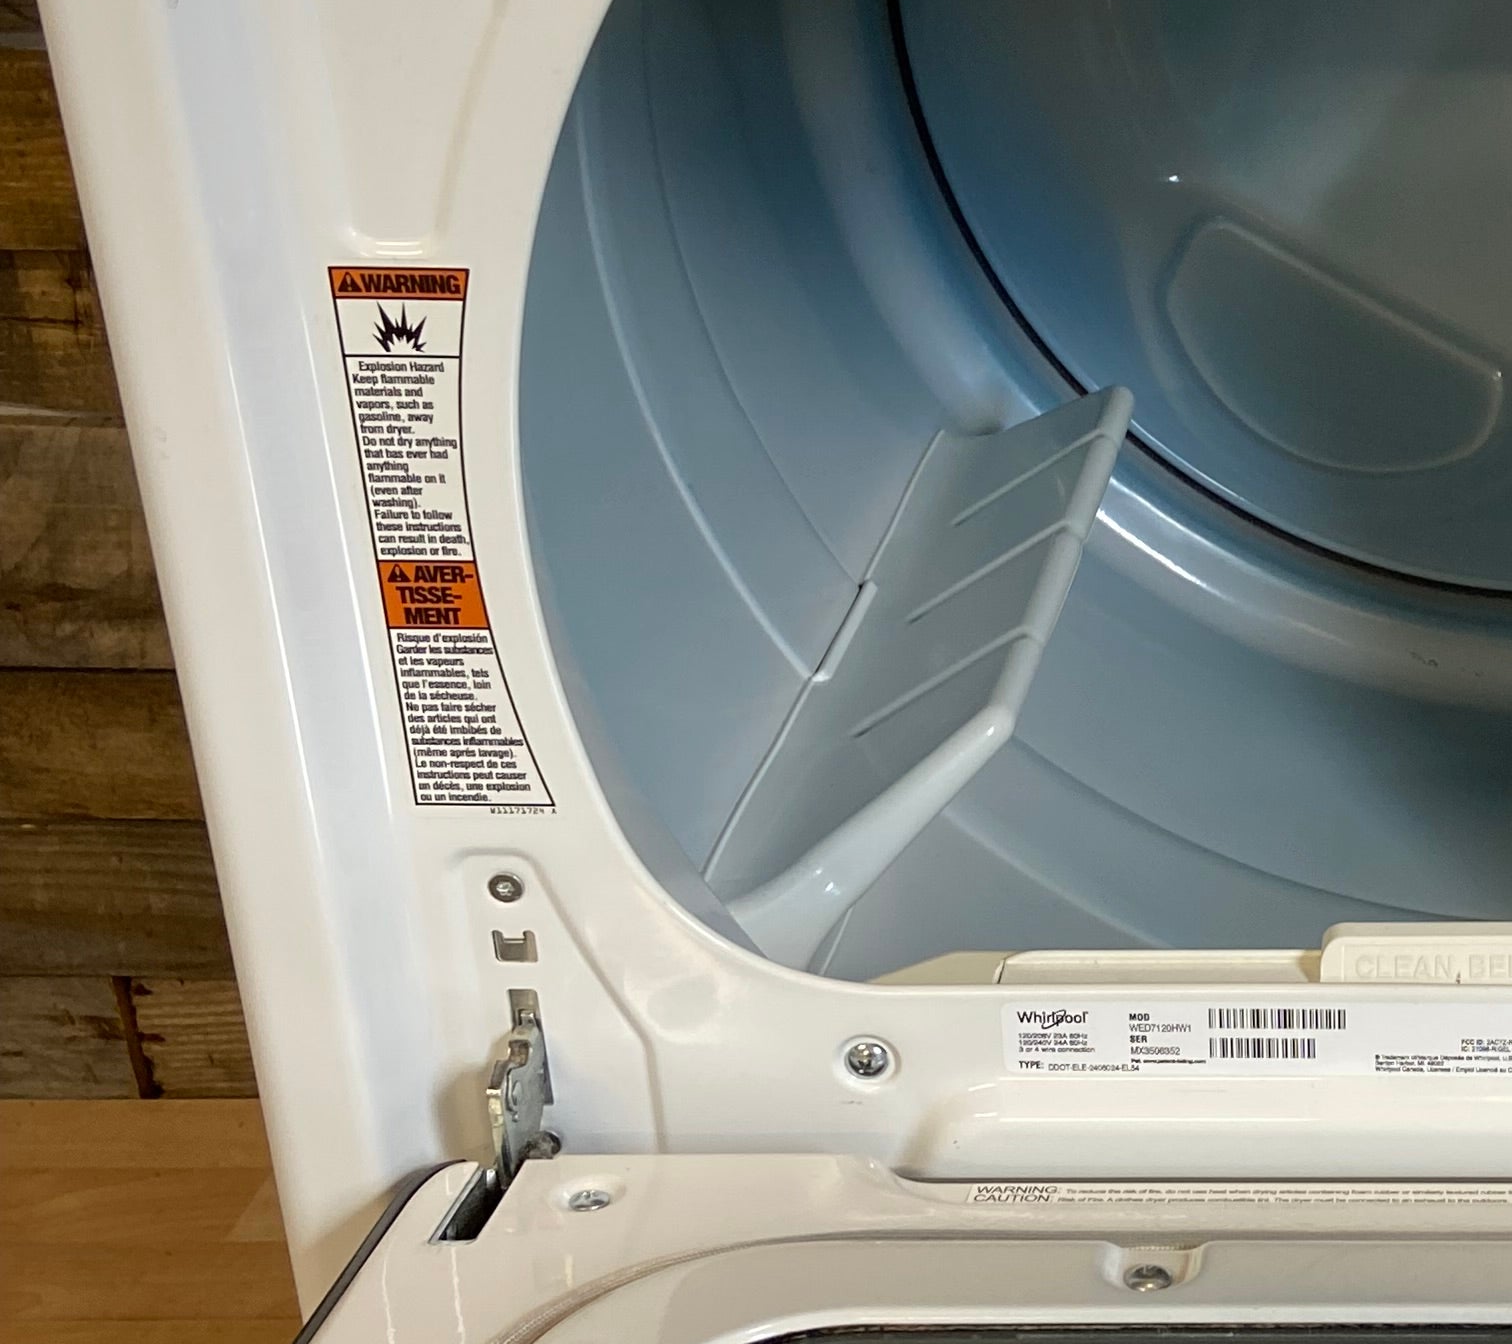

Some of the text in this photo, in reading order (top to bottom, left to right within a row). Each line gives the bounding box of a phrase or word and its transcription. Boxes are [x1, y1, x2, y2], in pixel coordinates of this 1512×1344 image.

[361, 274, 460, 294] WARNING
[359, 361, 444, 373] Explosion Hazard
[353, 374, 434, 386] Keep flammable
[355, 387, 423, 397] materials and
[356, 400, 394, 411] vapors,
[397, 400, 419, 409] such
[359, 413, 433, 424] gasoline, away
[361, 425, 414, 435] from dryer.
[363, 437, 457, 449] Do not dry anything
[365, 449, 448, 459] that has ever had
[367, 461, 408, 472] anything
[369, 473, 445, 483] flammable on it
[371, 485, 422, 496] (even after
[373, 498, 420, 509] washing).
[375, 509, 452, 519] Failure to follow
[377, 522, 461, 532] these instructions
[379, 534, 469, 545] can result in death,
[381, 546, 461, 557] explosion or fire.
[415, 565, 473, 583] AVER-
[396, 586, 461, 604] TISSE-
[405, 607, 461, 625] MENT
[397, 633, 430, 644] Risque
[1355, 954, 1453, 978] CLEAN
[1017, 1009, 1088, 1029] Whirlpool
[1129, 1024, 1191, 1032] WED7120HW1
[1130, 1035, 1147, 1043] SER
[1019, 1060, 1044, 1069] TYPE:
